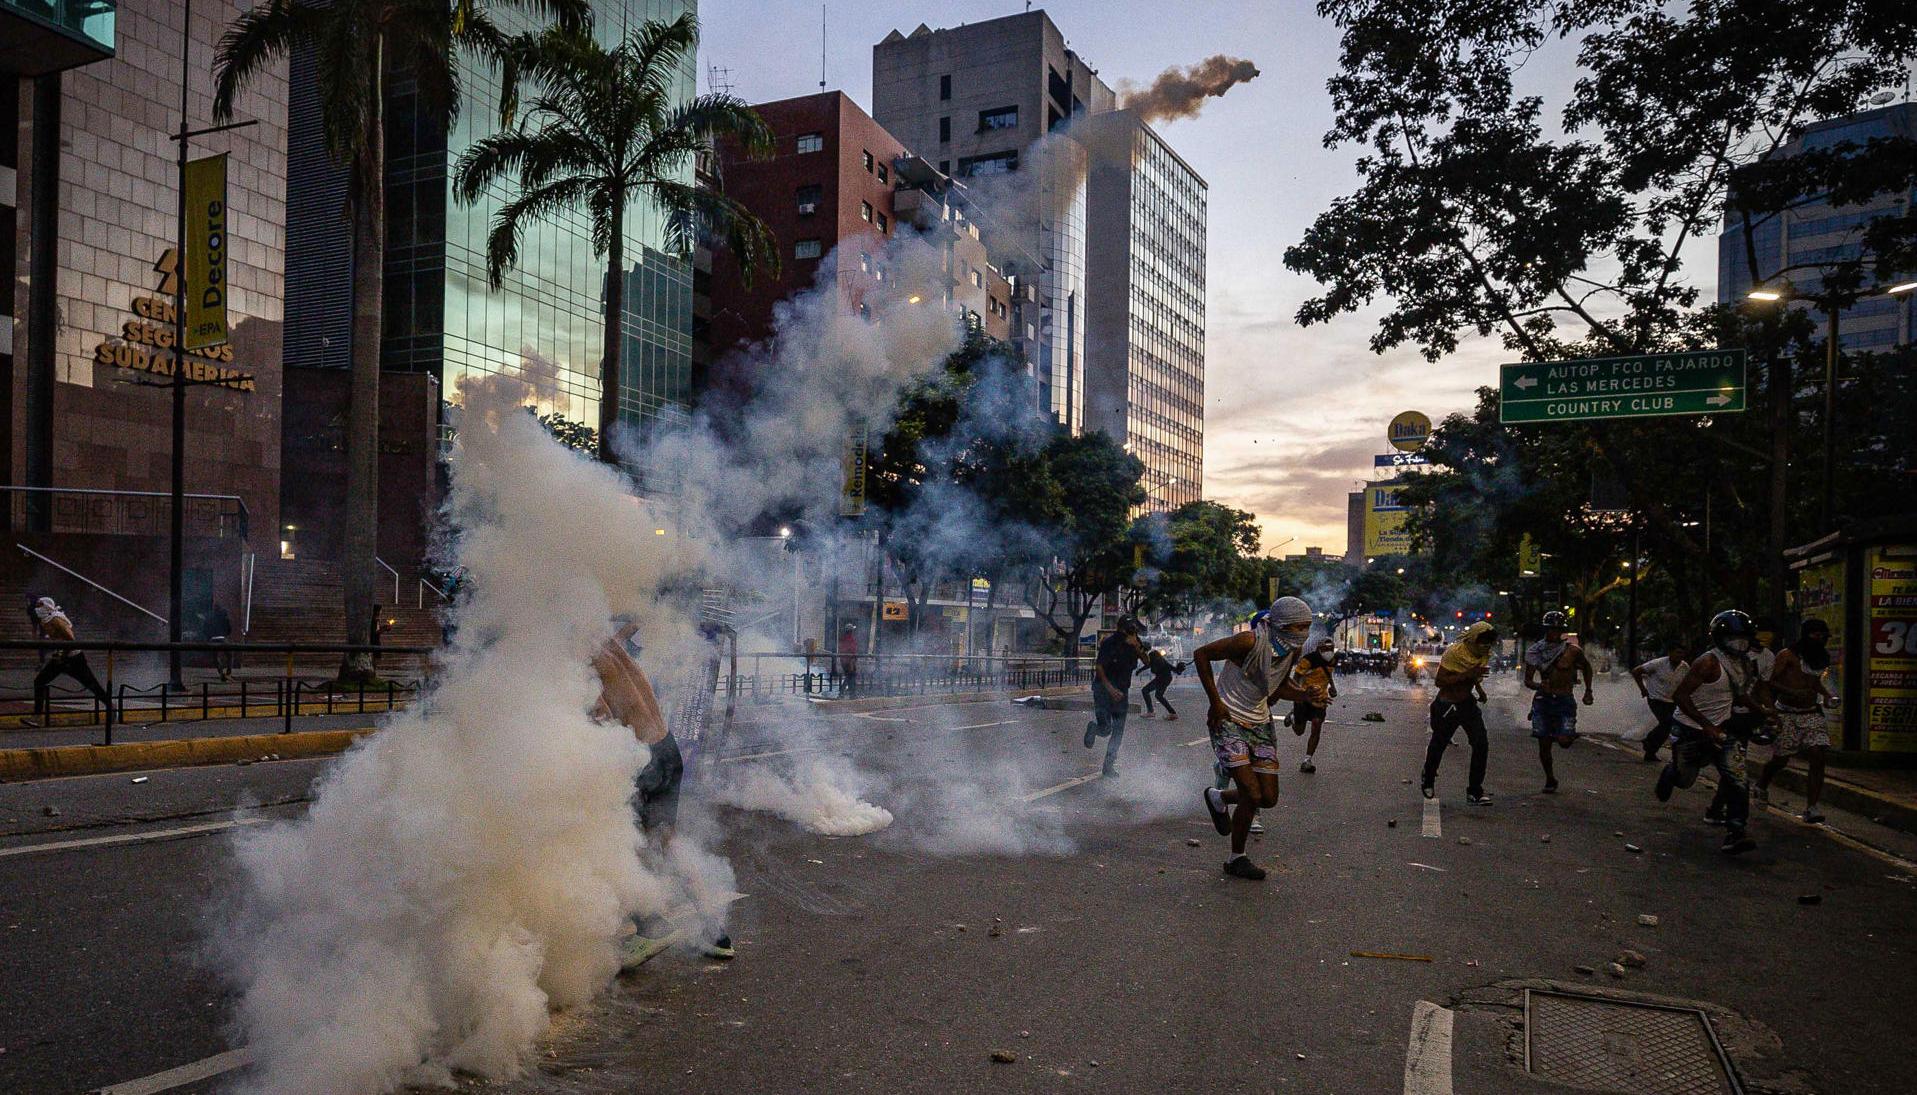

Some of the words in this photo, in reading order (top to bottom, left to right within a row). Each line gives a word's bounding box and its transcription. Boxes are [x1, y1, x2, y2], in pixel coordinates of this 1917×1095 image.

[203, 200, 222, 309] Decore
[1548, 364, 1605, 379] AUTOP.
[1612, 361, 1648, 375] FCO.
[1655, 355, 1734, 372] FAJARDO
[1547, 382, 1578, 395] LAS
[1586, 376, 1676, 392] MERCEDES
[1547, 400, 1622, 416] COUNTRY
[1631, 397, 1675, 410] CLUB
[1394, 422, 1427, 437] Daka
[1879, 597, 1892, 606] LA
